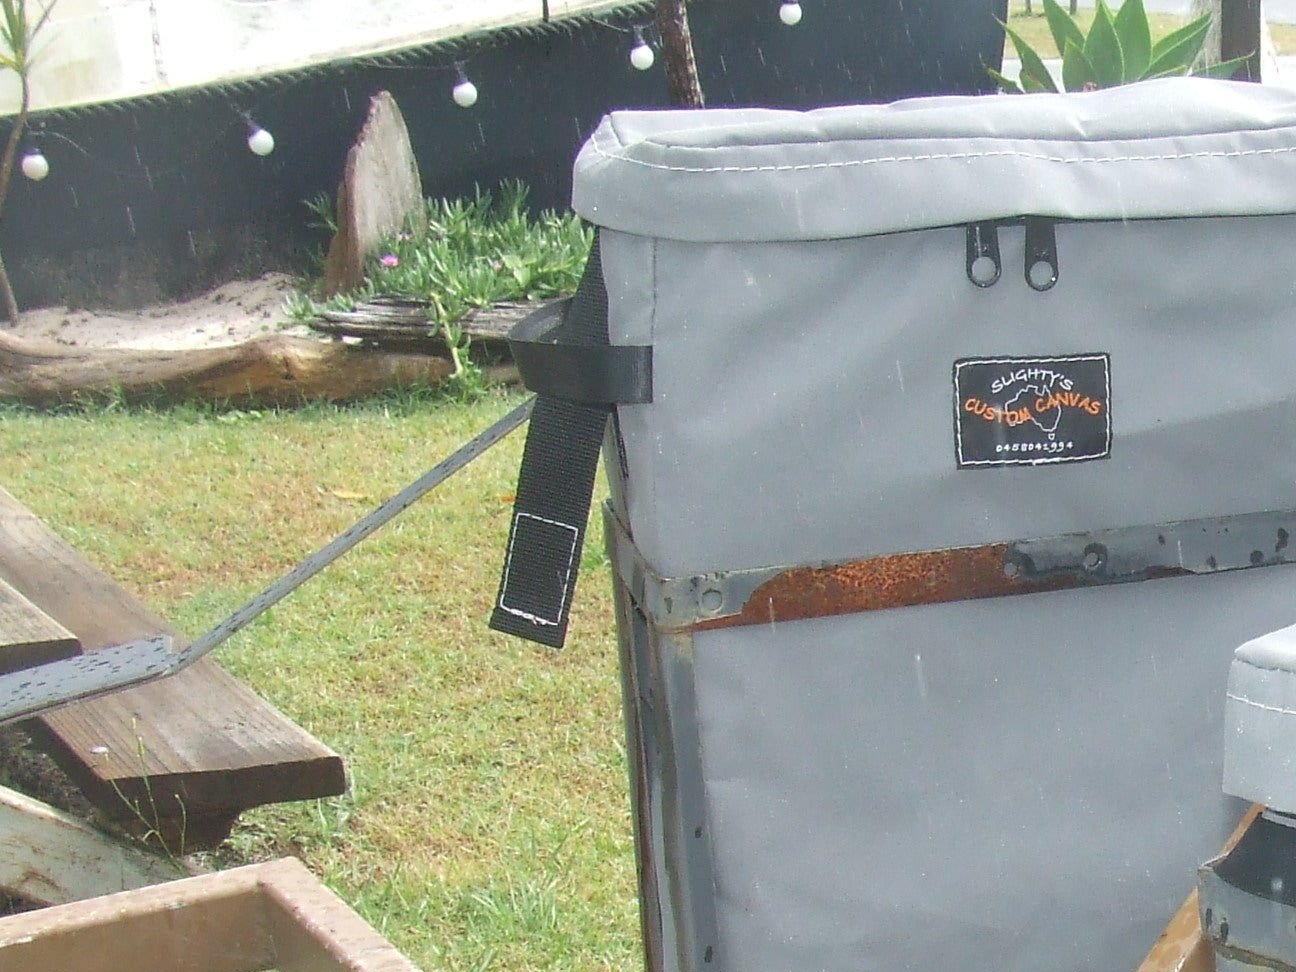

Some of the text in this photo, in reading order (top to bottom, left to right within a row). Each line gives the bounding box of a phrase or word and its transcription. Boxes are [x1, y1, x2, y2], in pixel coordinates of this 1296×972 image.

[991, 368, 1074, 394] SLIGHTY'S
[964, 391, 1102, 427] CUSTOM CANVAS
